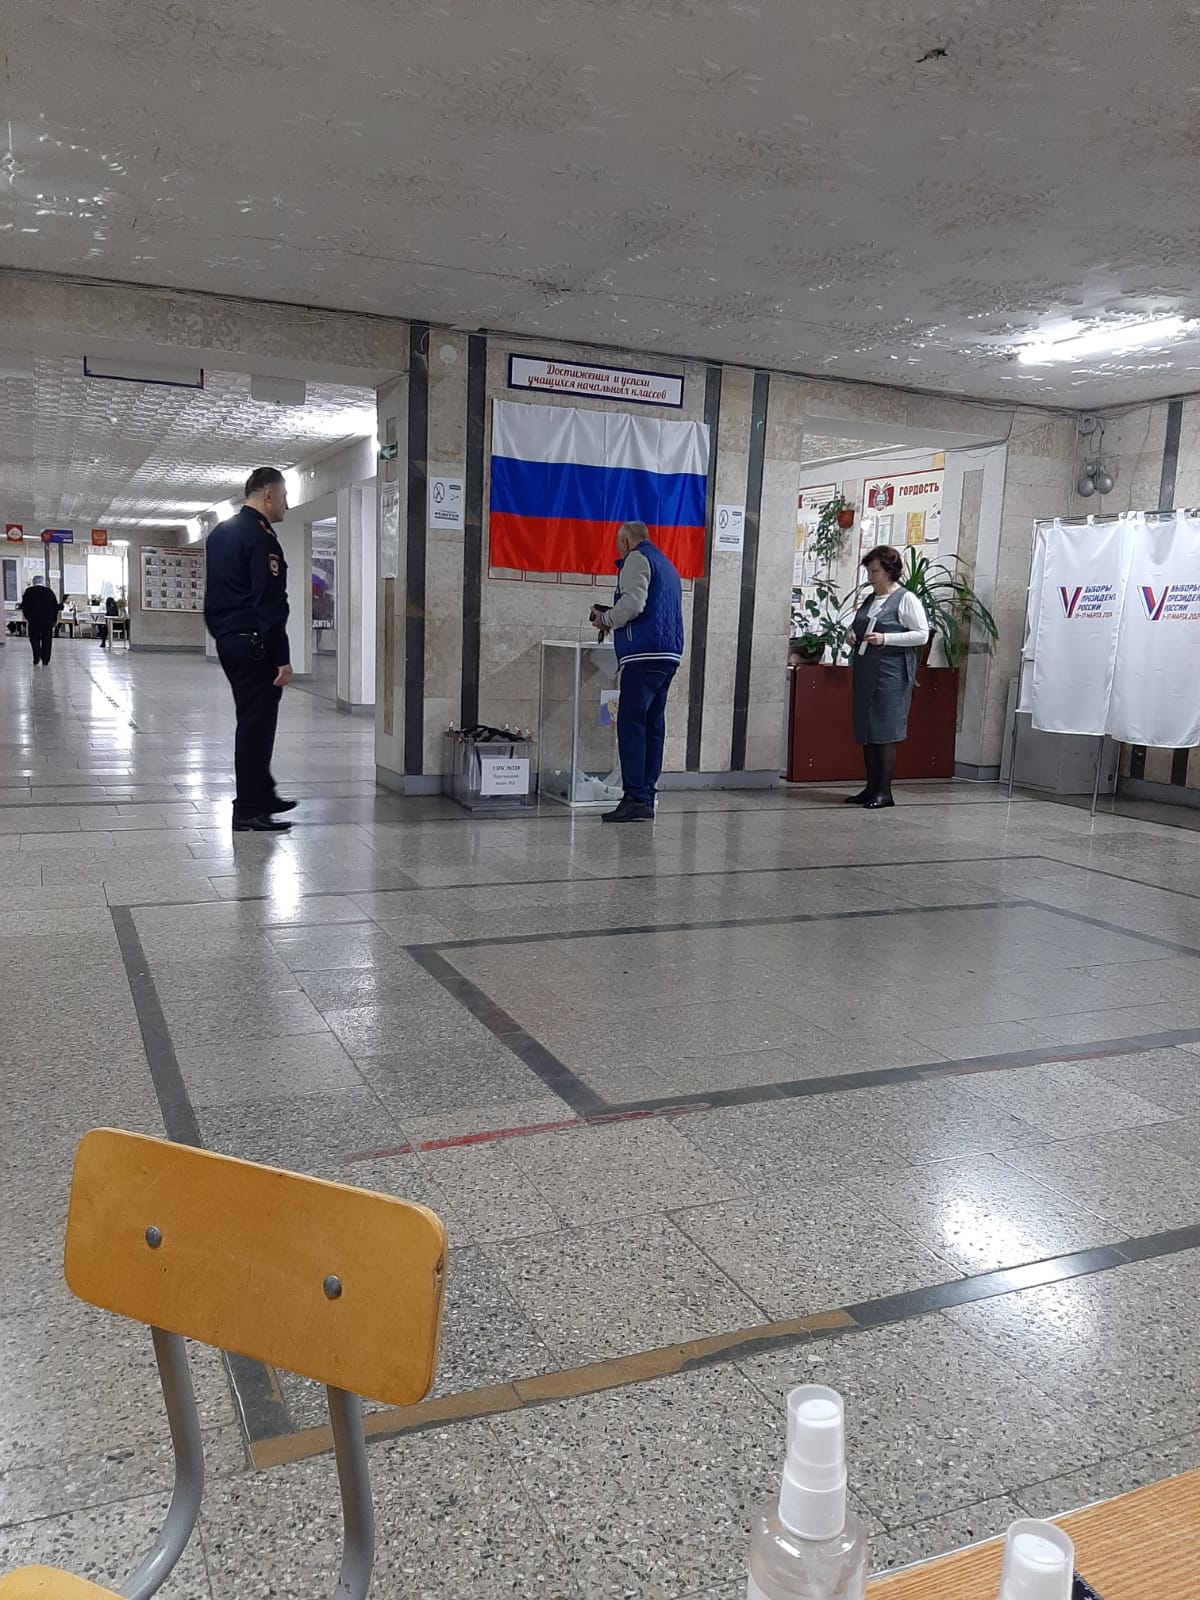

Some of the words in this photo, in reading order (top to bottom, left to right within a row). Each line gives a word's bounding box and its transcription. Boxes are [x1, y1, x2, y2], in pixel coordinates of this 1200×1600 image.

[528, 374, 575, 388] учащихся
[577, 381, 629, 396] начальных
[631, 387, 667, 400] классов
[547, 364, 610, 382] Достижения
[613, 375, 620, 383] и
[621, 376, 650, 388] успехи
[899, 482, 940, 497] ГОРДОСТЬ
